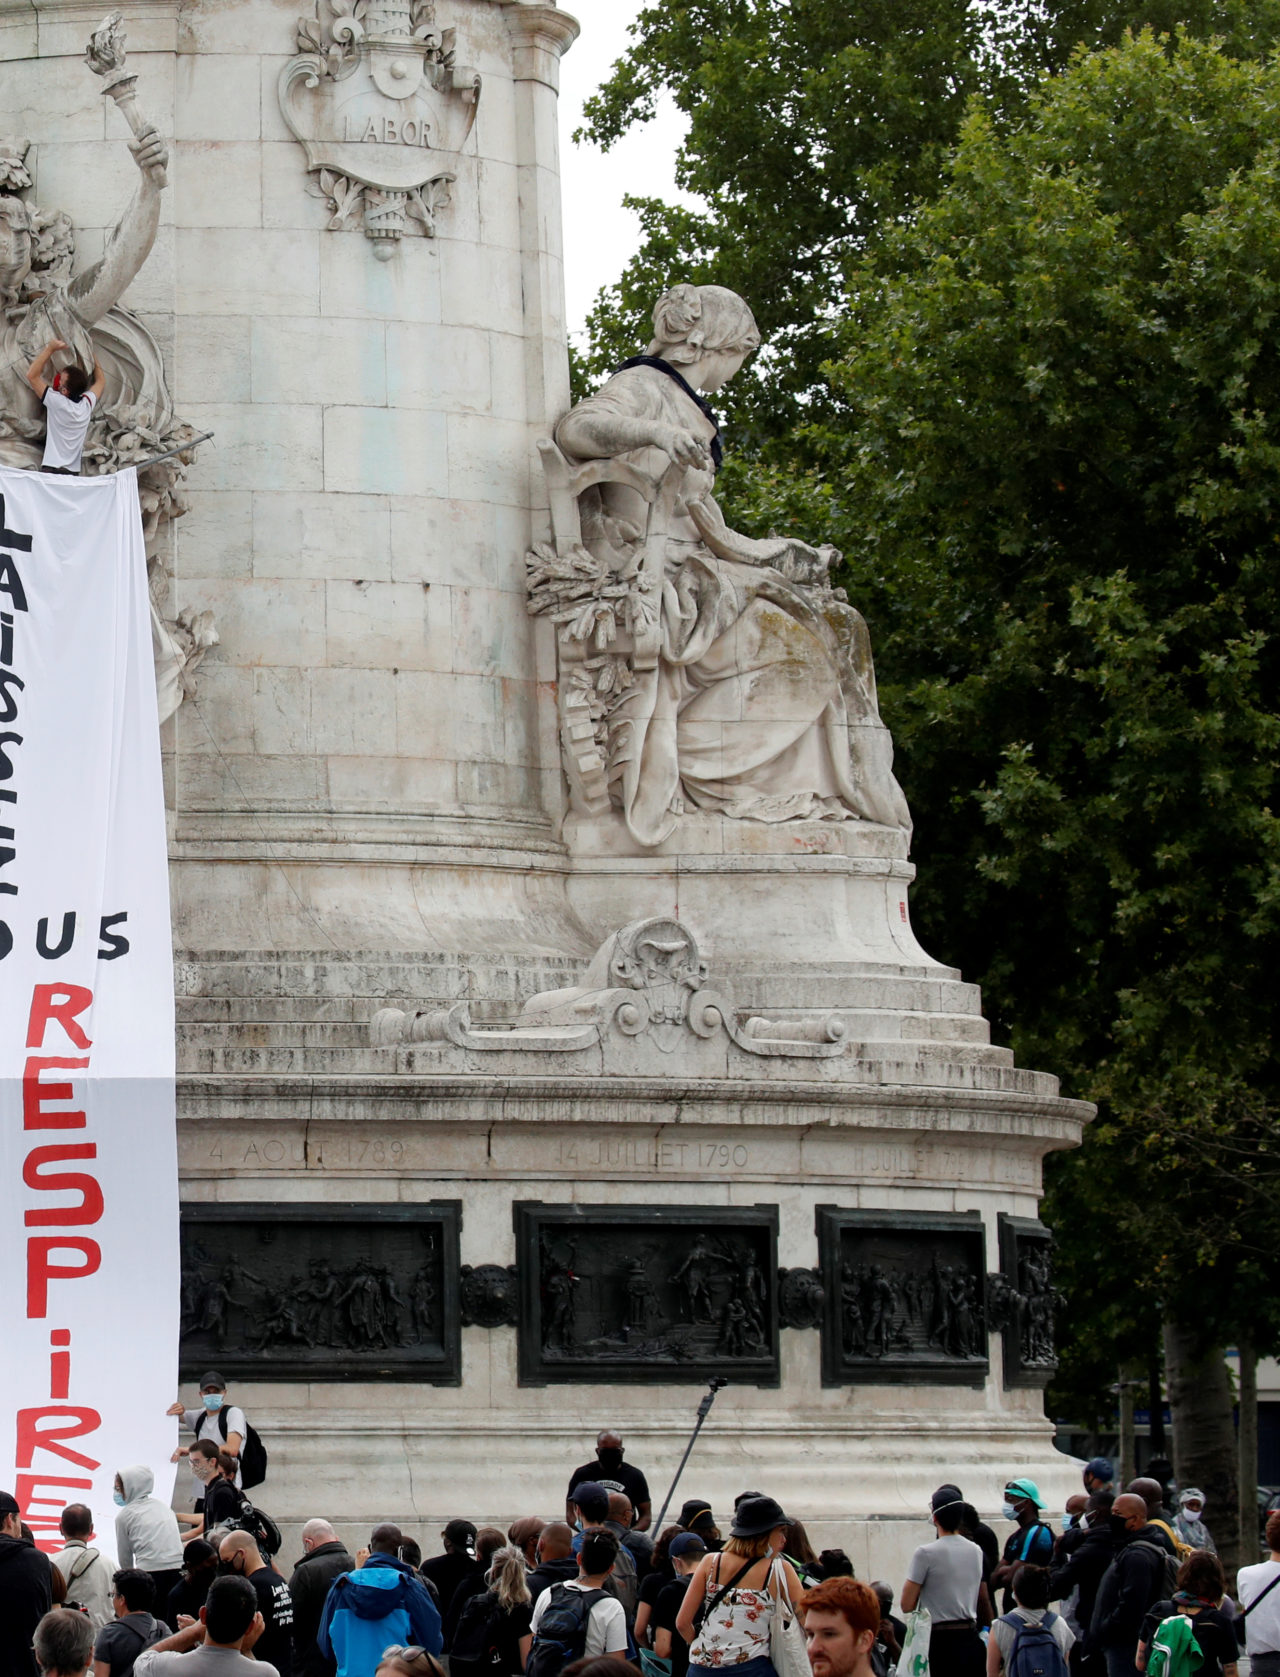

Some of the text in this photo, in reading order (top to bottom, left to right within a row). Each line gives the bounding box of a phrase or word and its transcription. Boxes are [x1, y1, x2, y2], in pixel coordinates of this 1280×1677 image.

[342, 115, 432, 149] LABOR
[208, 1139, 406, 1164] 4 AOUT 1789
[555, 1142, 748, 1168] 14 JUILLET 1790
